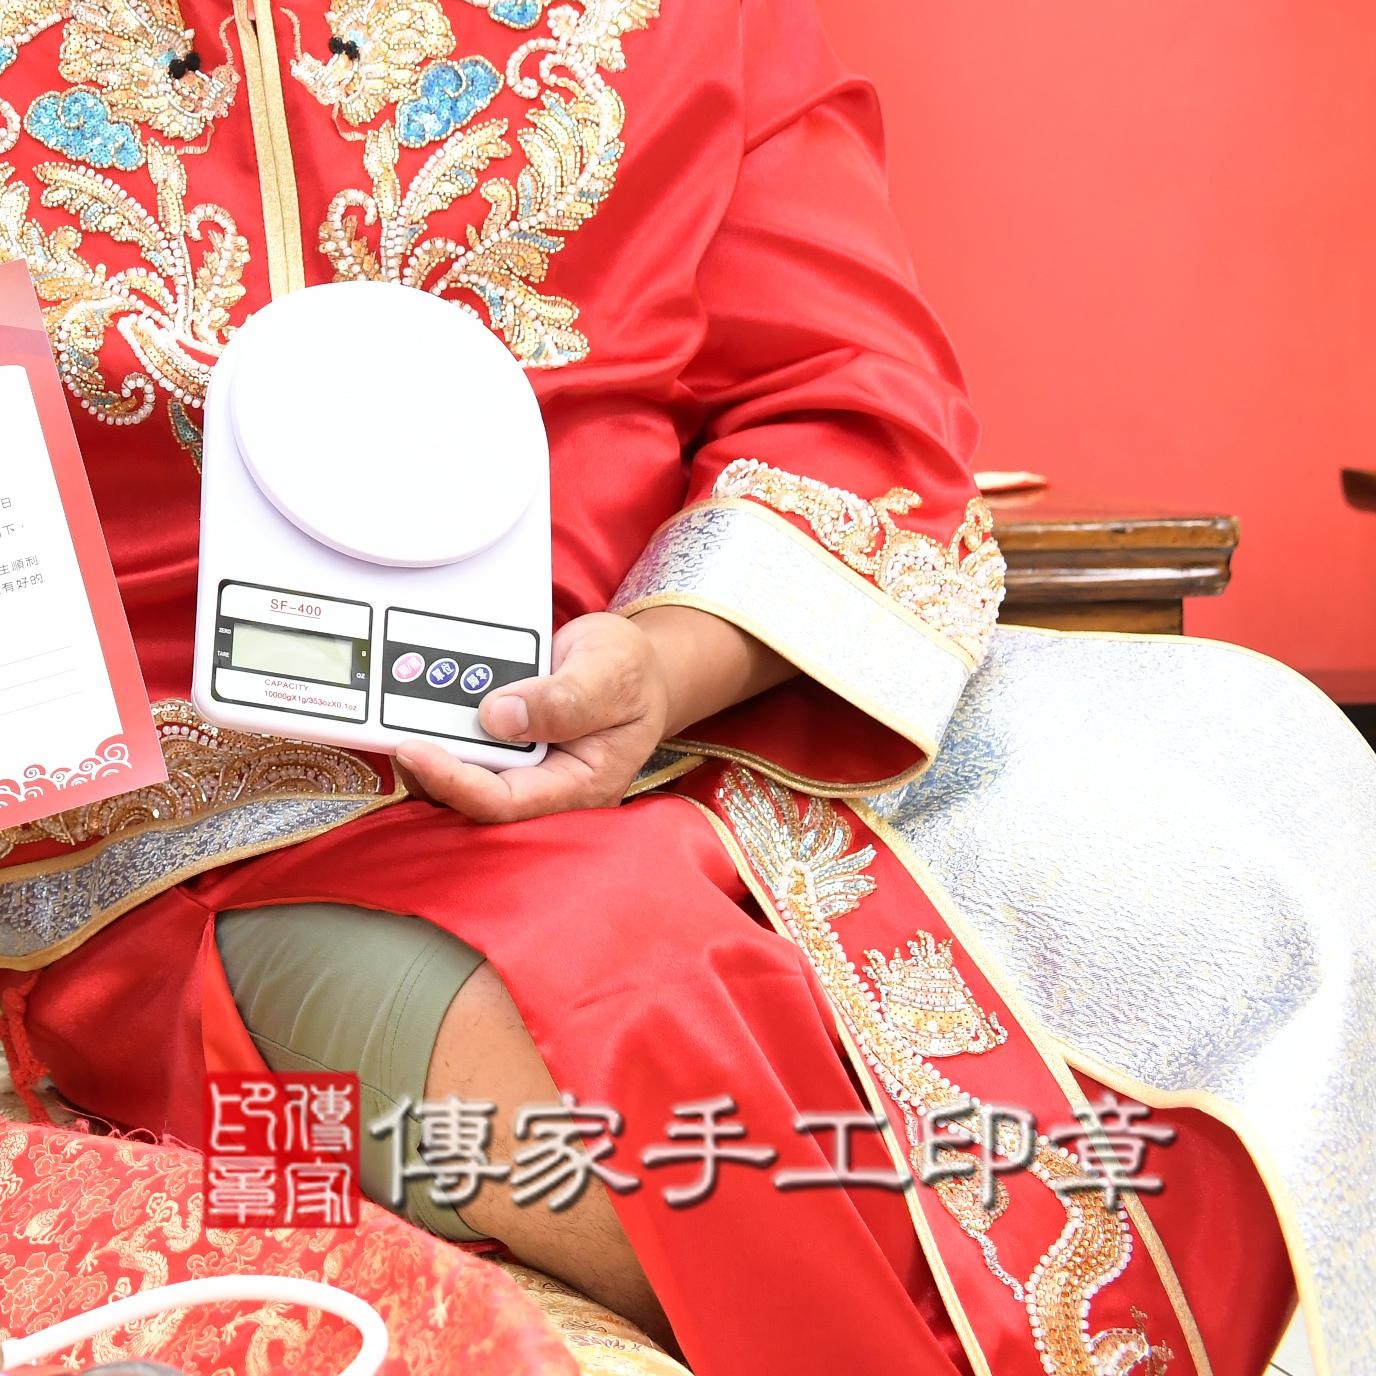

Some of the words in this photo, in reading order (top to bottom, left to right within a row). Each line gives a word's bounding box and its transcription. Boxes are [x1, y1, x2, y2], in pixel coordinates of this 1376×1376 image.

[270, 598, 322, 617] SF-400
[218, 627, 232, 635] ZERO
[217, 650, 230, 658] TARE
[264, 679, 310, 692] CAPACITY
